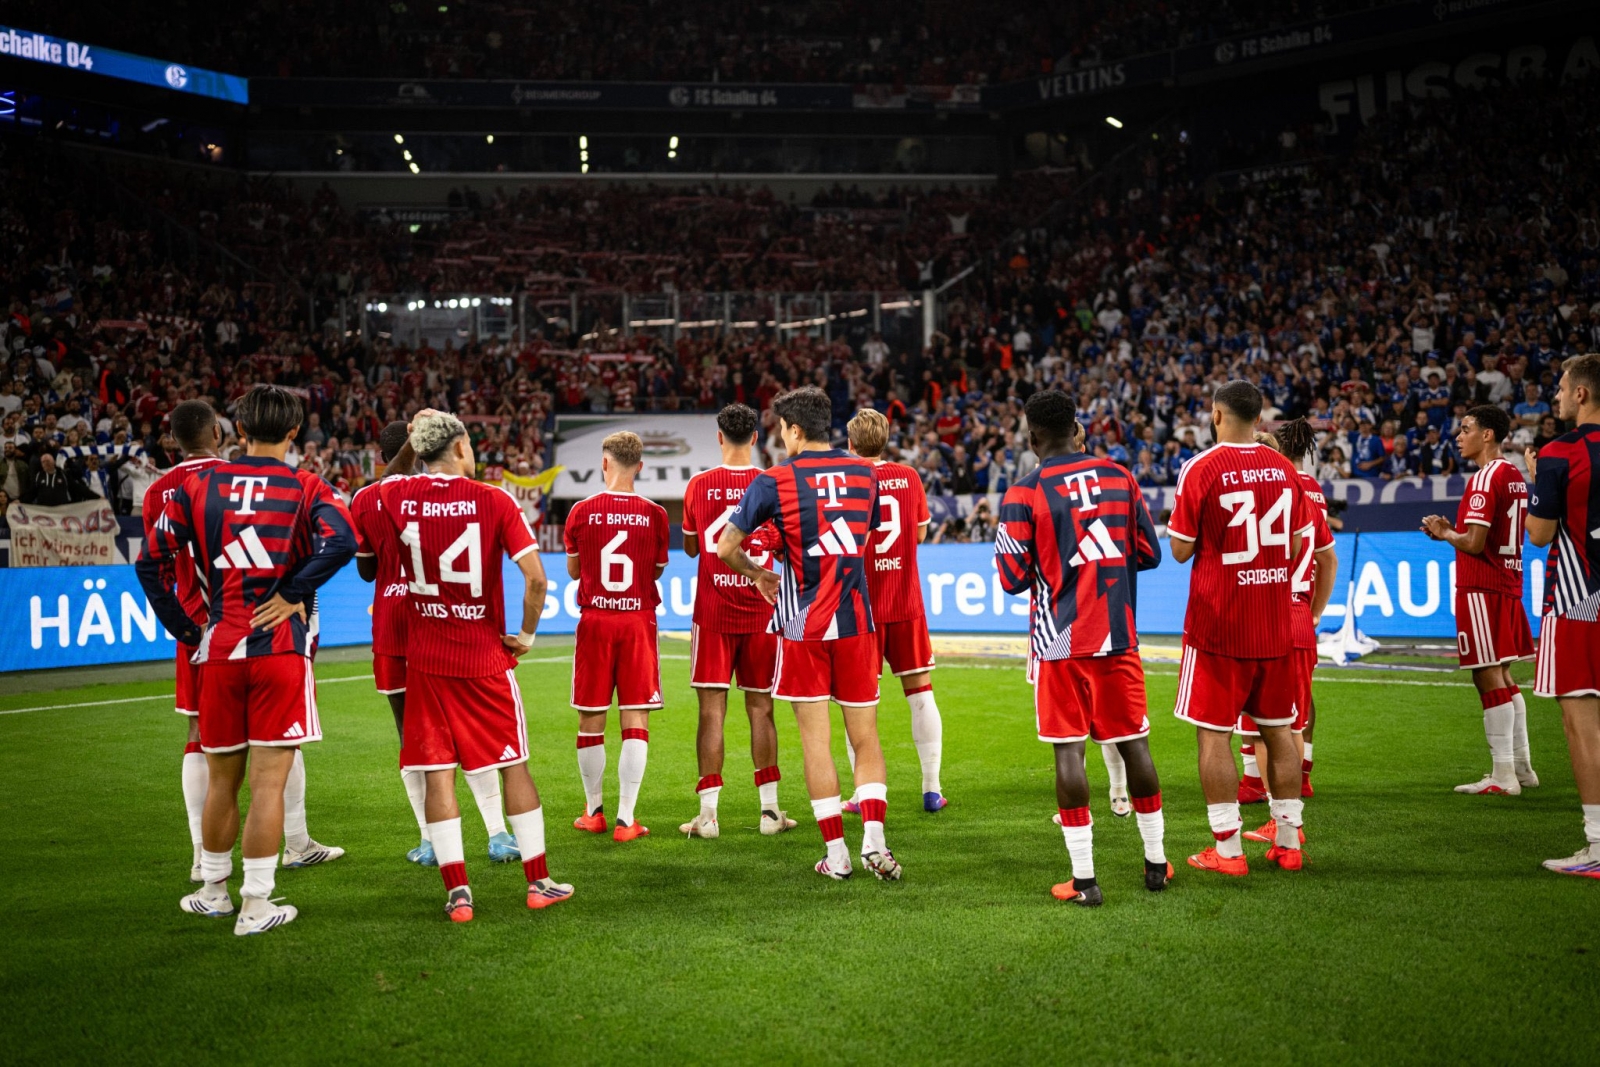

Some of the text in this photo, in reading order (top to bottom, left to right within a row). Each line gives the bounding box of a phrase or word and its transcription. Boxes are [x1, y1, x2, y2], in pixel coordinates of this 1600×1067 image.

[67, 42, 94, 71] 04
[1038, 63, 1126, 100] VELTINS
[1221, 467, 1287, 486] FC BAYERN
[707, 488, 722, 501] FC
[400, 500, 418, 515] FC
[422, 500, 477, 517] BAYERN
[11, 504, 117, 534] Jonas
[588, 513, 650, 527] FC BAYERN
[1219, 488, 1292, 565] 34
[14, 532, 37, 547] ich
[42, 537, 108, 557] wünsche
[22, 551, 49, 567] mir
[399, 521, 483, 599] 14
[600, 530, 634, 592] 6
[874, 557, 902, 572] KANE
[1237, 567, 1288, 586] SAIBARI
[415, 601, 486, 620] LUIS DÍAZ
[591, 595, 641, 611] KIMMICH
[30, 578, 177, 650] HÄN
